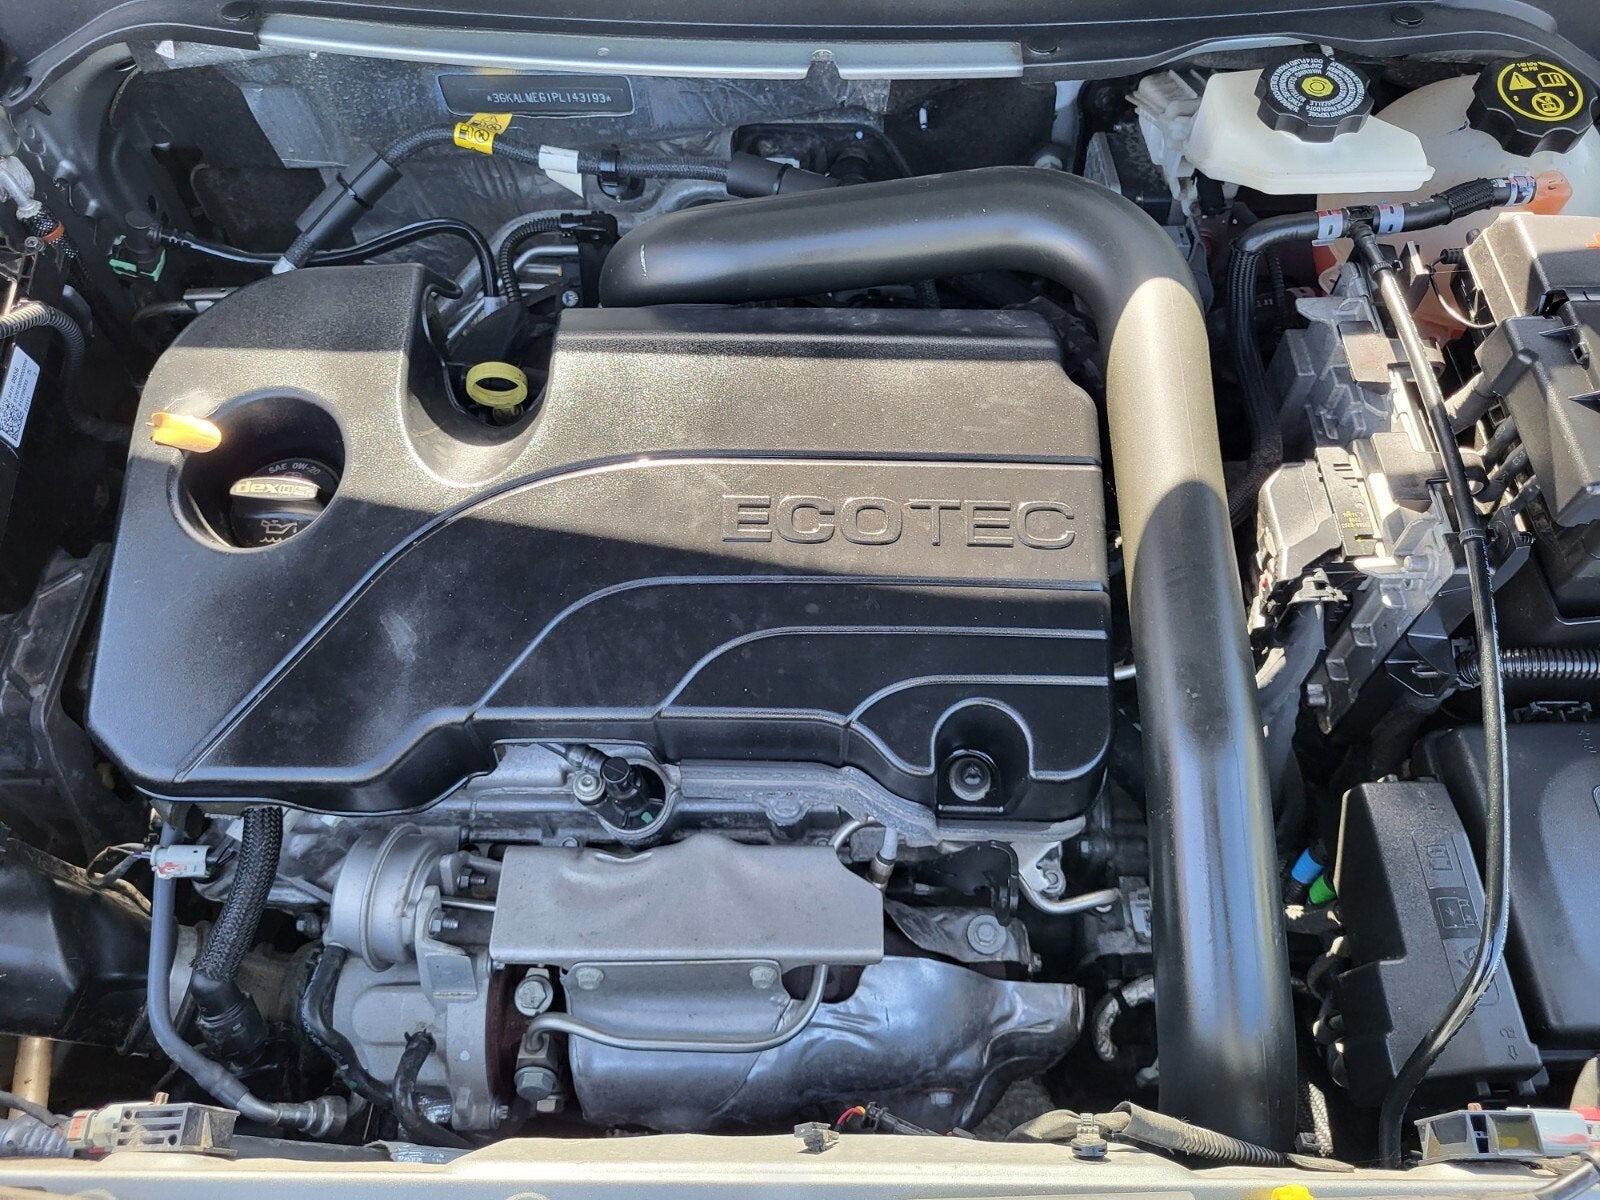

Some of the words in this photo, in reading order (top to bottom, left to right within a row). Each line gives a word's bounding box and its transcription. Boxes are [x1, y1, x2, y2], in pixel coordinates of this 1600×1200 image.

[268, 463, 287, 474] SAE
[292, 462, 321, 475] 0W-20
[235, 481, 309, 496] dexos
[722, 494, 1075, 550] ECOTEC
